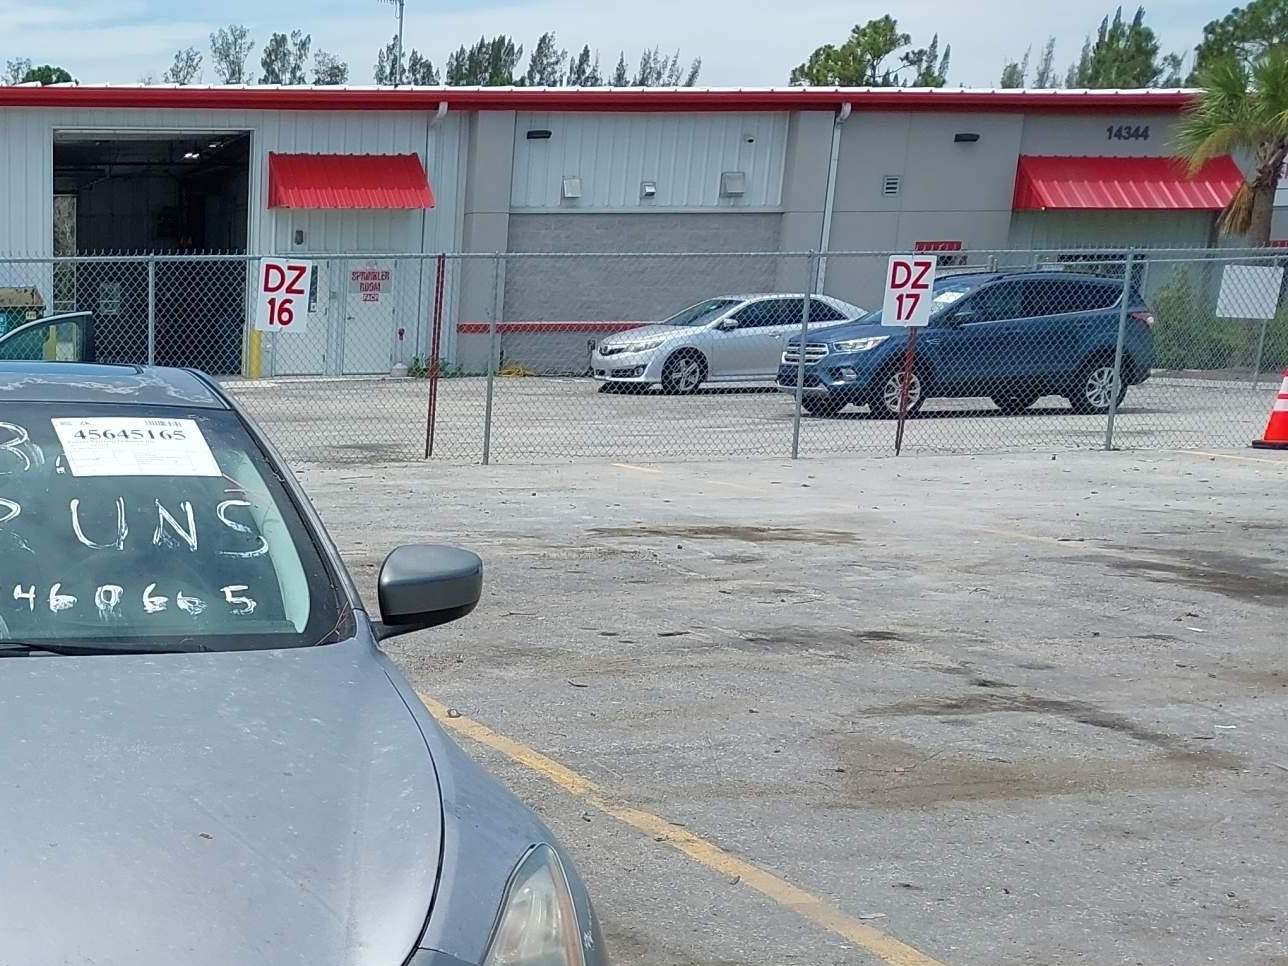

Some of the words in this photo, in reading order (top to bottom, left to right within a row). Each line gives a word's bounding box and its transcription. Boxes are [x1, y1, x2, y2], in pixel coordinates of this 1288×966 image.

[1106, 125, 1150, 141] 14344
[263, 263, 307, 295] DZ
[891, 261, 932, 289] DZ
[267, 297, 294, 326] 16
[895, 293, 921, 321] 17
[73, 428, 187, 441] 45645165
